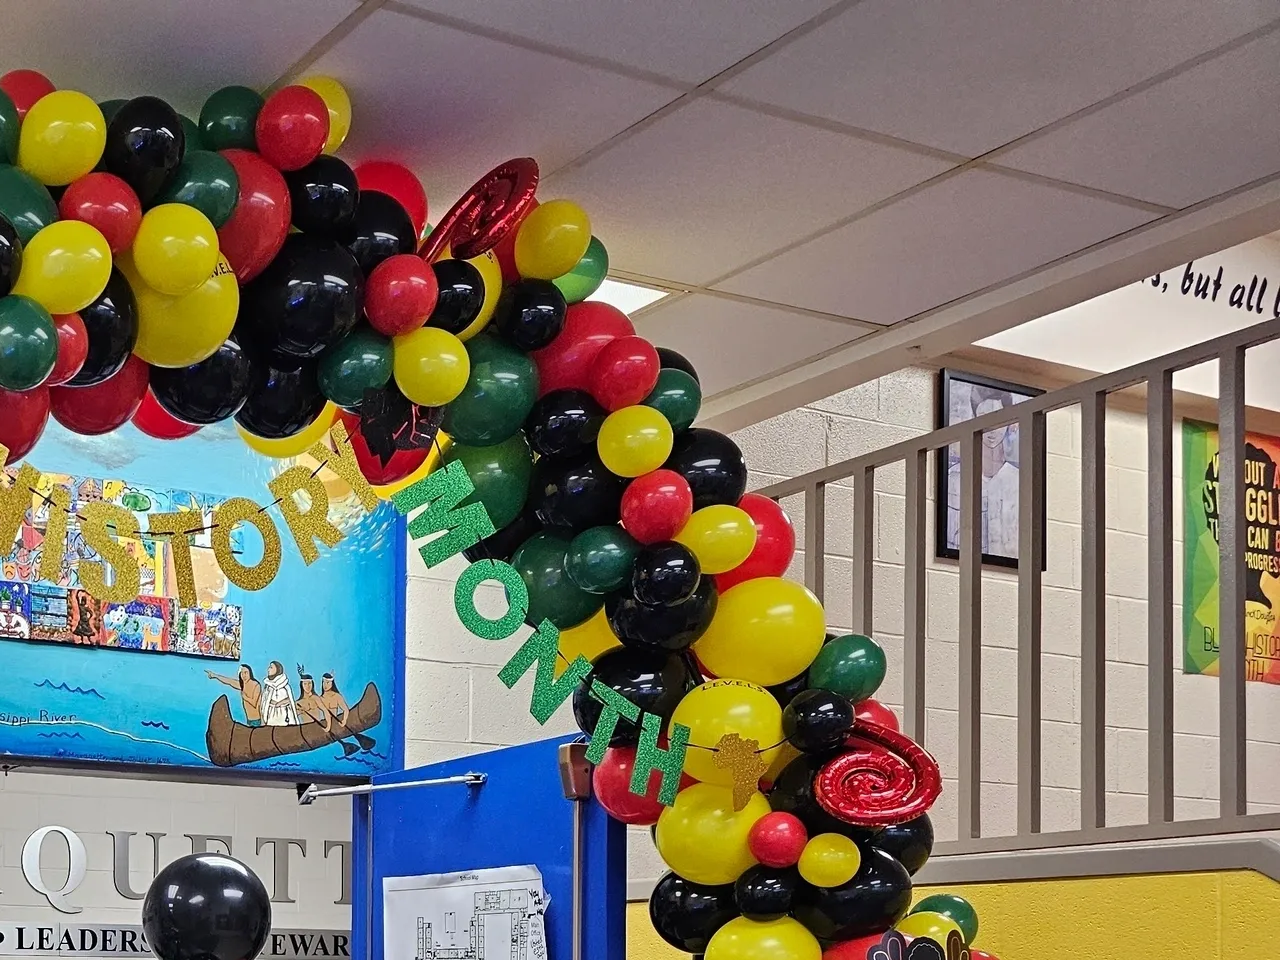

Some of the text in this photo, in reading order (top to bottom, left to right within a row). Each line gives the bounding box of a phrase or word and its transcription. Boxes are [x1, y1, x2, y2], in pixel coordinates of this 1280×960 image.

[1181, 260, 1224, 302] but
[1229, 274, 1268, 315] all
[1247, 525, 1269, 550] CAN
[390, 459, 692, 807] MONTH
[39, 709, 77, 722] River
